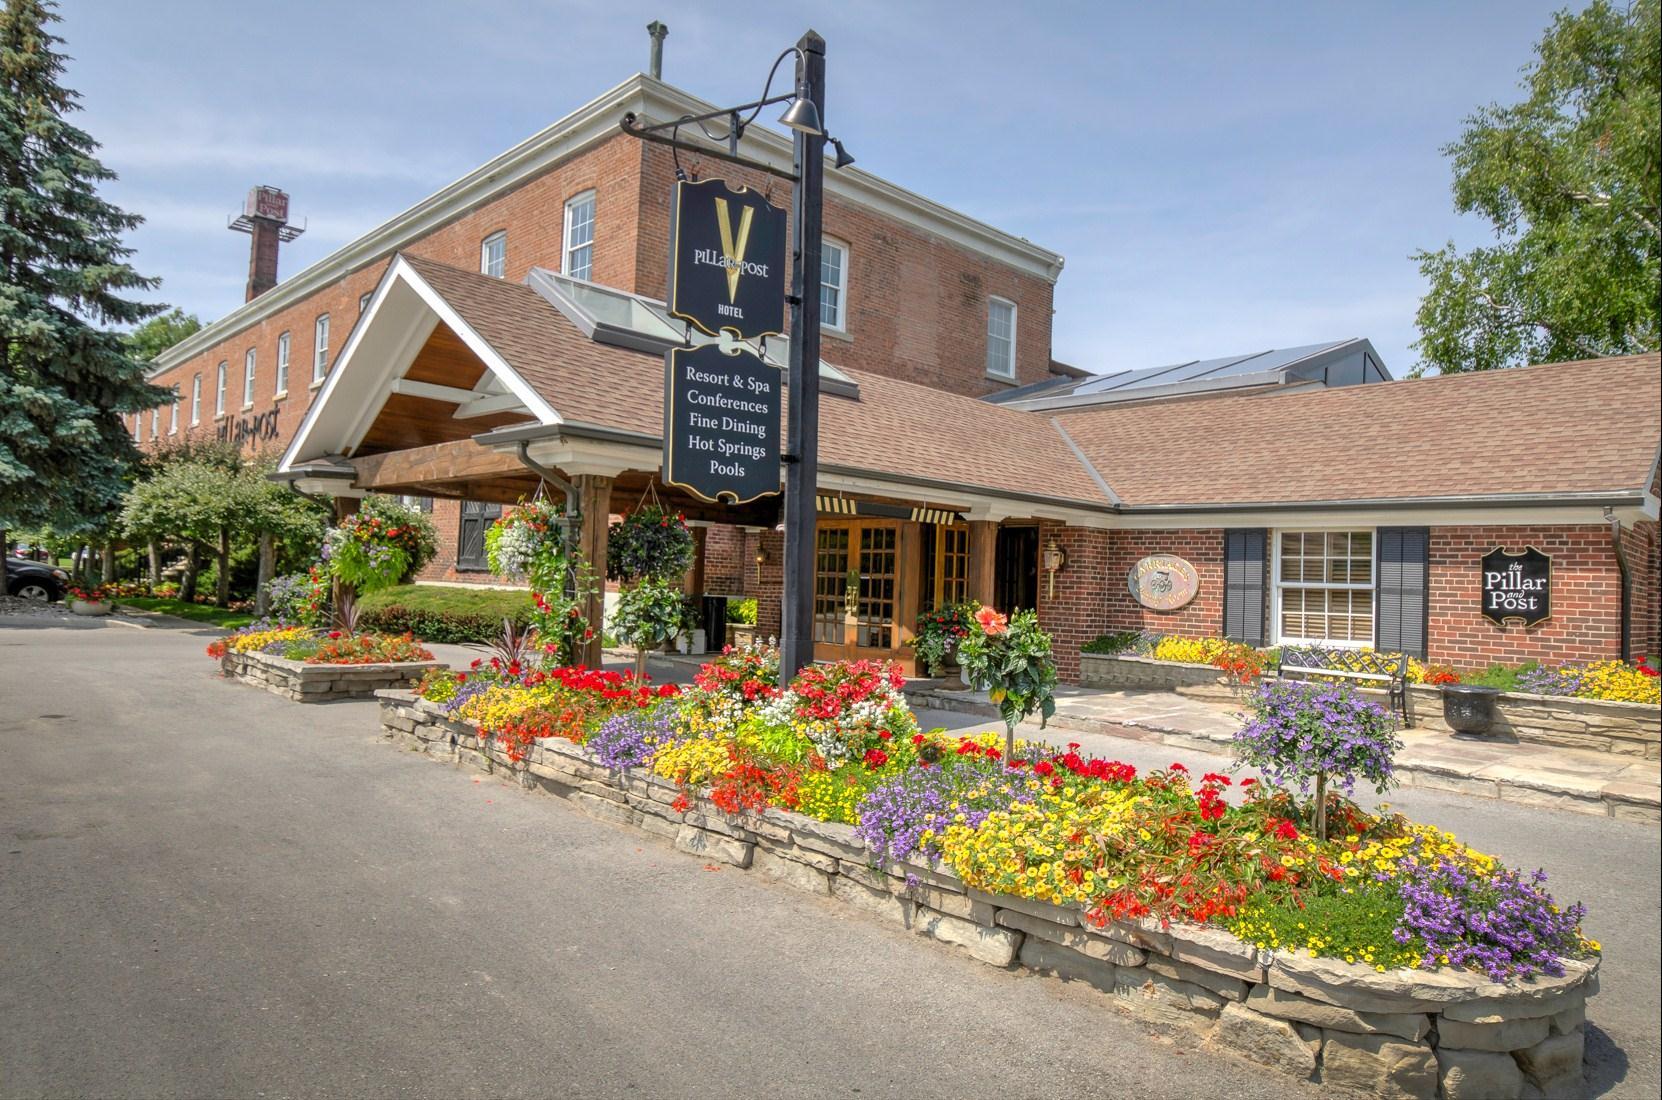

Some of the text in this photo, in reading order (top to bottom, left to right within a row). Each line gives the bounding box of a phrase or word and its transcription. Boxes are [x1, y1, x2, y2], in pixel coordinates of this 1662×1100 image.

[717, 303, 744, 319] HOTEL
[686, 366, 770, 395] Resort & Spa
[687, 389, 768, 414] Conferences
[689, 412, 767, 439] Fine Dining
[688, 435, 766, 460] Hot Springs
[709, 460, 745, 477] Pools
[1508, 561, 1523, 571] the
[1484, 571, 1547, 590] Pillar
[1489, 591, 1538, 610] Post
[1507, 590, 1525, 598] and
